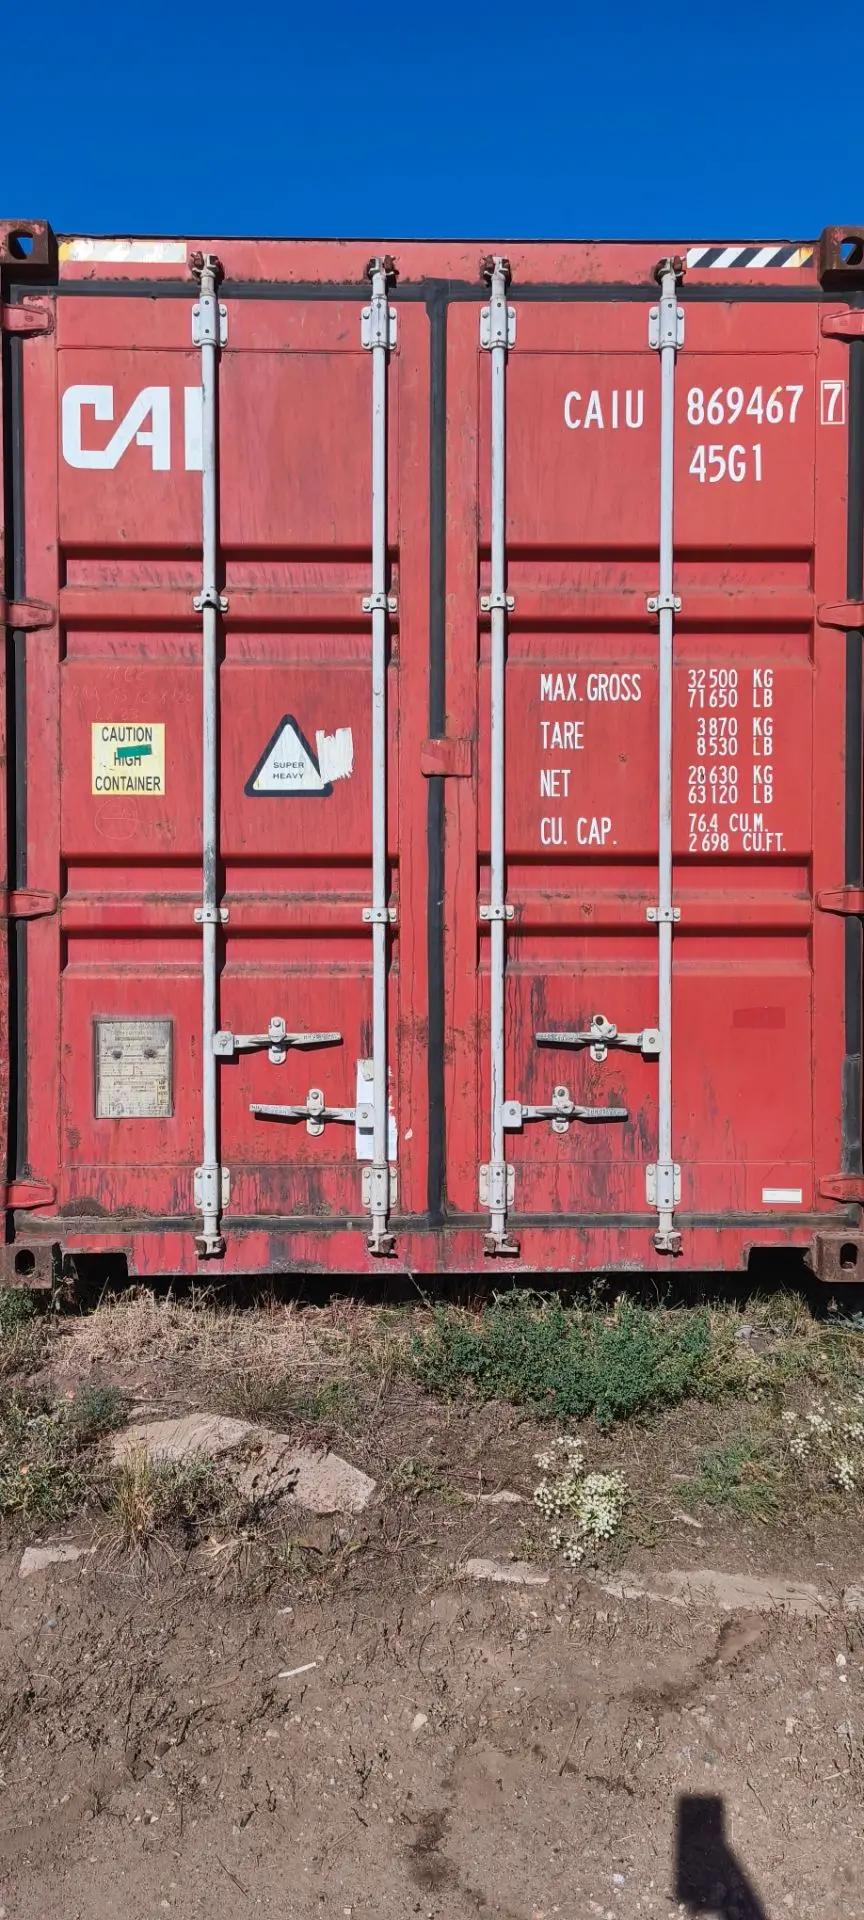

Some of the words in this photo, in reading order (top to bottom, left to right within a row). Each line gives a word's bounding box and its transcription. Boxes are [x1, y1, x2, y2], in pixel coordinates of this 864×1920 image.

[564, 390, 644, 429] CAIU
[687, 384, 804, 425] 869467
[822, 382, 843, 423] 7
[62, 384, 203, 471] CAI
[689, 443, 762, 483] 45G1
[753, 668, 774, 688] KG
[752, 689, 773, 708] LB
[101, 726, 153, 742] CAUTION
[540, 721, 584, 749] TARE
[752, 716, 773, 736] KG
[752, 737, 773, 756] LB
[113, 751, 142, 767] HIGH
[273, 761, 305, 769] SUPER
[95, 775, 161, 792] CONTAINER
[273, 772, 304, 780] HEAVY
[540, 769, 571, 797] NET
[753, 765, 773, 785] KG
[753, 786, 773, 804] LB
[540, 817, 568, 845] CU.
[577, 817, 617, 845] CAP.
[689, 813, 719, 832] 76.4
